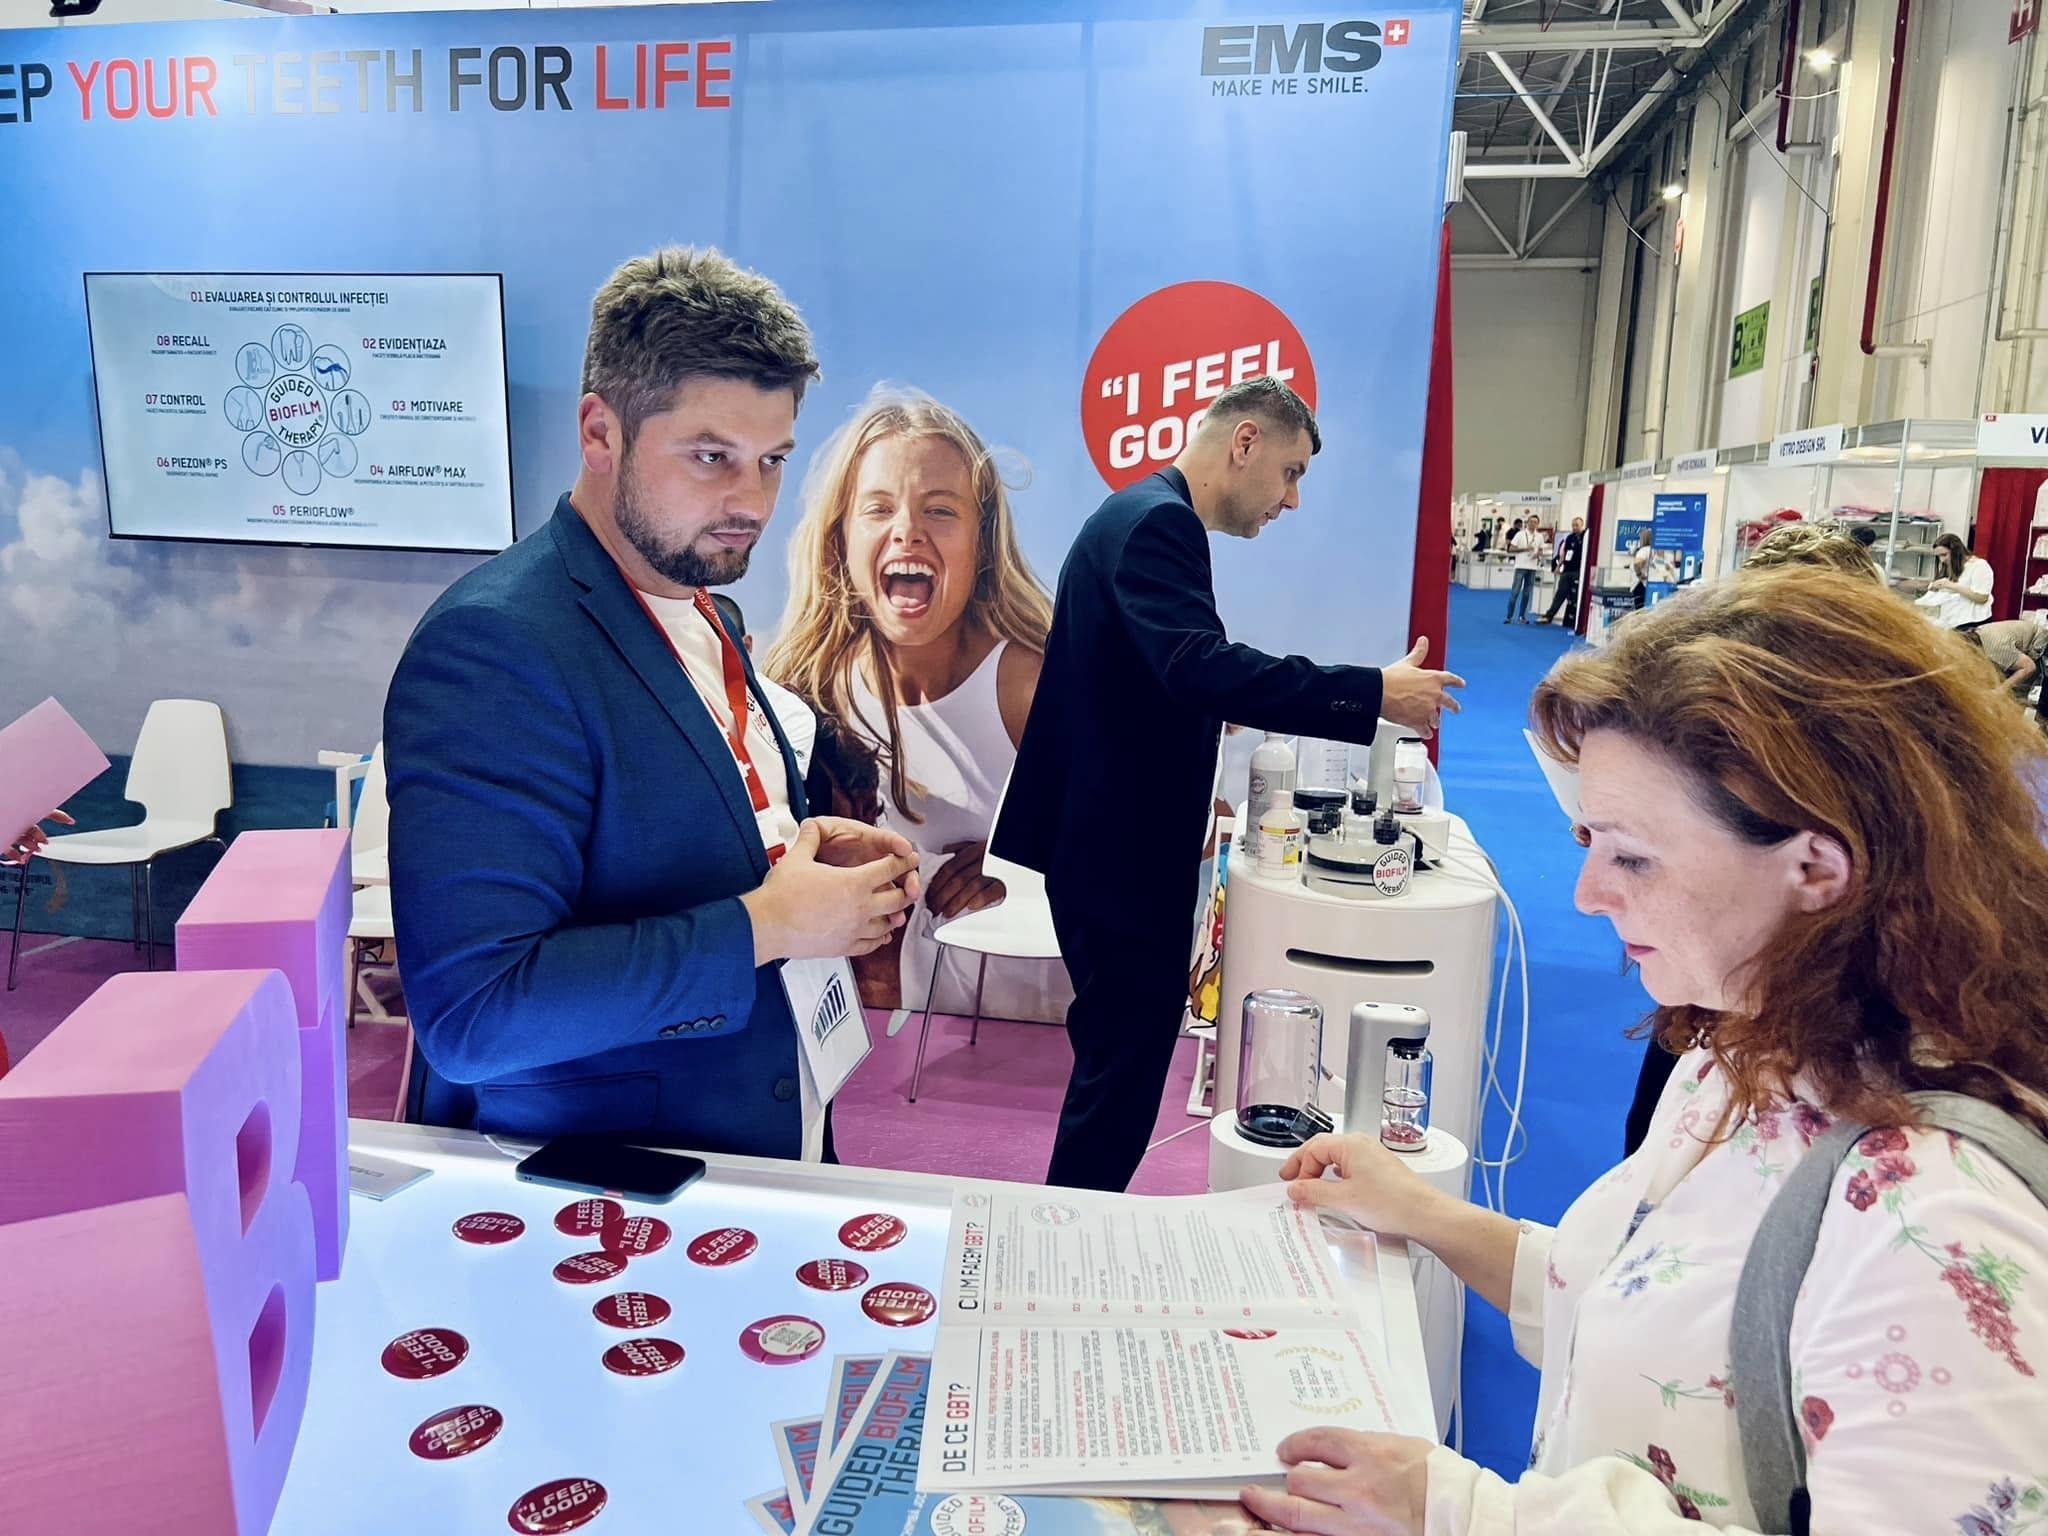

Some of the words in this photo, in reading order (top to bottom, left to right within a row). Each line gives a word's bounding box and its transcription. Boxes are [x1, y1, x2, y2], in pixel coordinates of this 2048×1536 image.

[1201, 20, 1382, 76] EMS
[67, 57, 218, 120] YOUR
[233, 49, 423, 115] TEETH
[448, 46, 573, 111] FOR
[595, 42, 731, 110] LIFE
[1212, 80, 1262, 97] MAKE
[1272, 79, 1298, 95] ME
[1307, 77, 1369, 94] SMILE.
[191, 291, 204, 303] 01
[205, 291, 264, 303] EVALUAREA
[278, 292, 338, 304] CONTROLUL
[156, 335, 170, 346] 08
[172, 335, 210, 347] RECALL
[362, 338, 376, 349] 02
[1162, 340, 1294, 408] FEEL
[145, 394, 158, 405] 07
[160, 394, 206, 406] CONTROL
[270, 379, 314, 403] GUIDED
[269, 400, 321, 421] BIOFILM
[392, 400, 406, 411] 03
[411, 400, 463, 412] MOTIVARE
[1109, 409, 1209, 470] GO
[156, 456, 170, 467] 06
[215, 458, 228, 470] PS
[370, 465, 384, 476] 04
[444, 467, 466, 478] MAX
[272, 505, 286, 516] 05
[1379, 852, 1407, 867] GUIDED
[1376, 866, 1407, 878] BIOFILM
[577, 1200, 590, 1219] FEEL
[460, 1221, 499, 1231] FEEL
[623, 1218, 641, 1238] FEEL
[860, 1214, 891, 1233] FEEL
[963, 1221, 985, 1246] GBT?
[709, 1229, 741, 1248] FEEL
[585, 1257, 618, 1272] FEEL
[960, 1247, 983, 1275] FACEM
[833, 1266, 847, 1286] FEEL
[867, 1298, 908, 1309] FEEL
[958, 1279, 979, 1310] CUM
[632, 1301, 649, 1324] FEEL
[398, 1335, 430, 1358] FEEL
[641, 1346, 668, 1370] FEEL
[946, 1383, 972, 1419] GBT?
[945, 1424, 969, 1447] CE
[816, 1444, 888, 1536] GUIDED
[863, 1357, 929, 1440] BIOFILM
[942, 1449, 967, 1473] DE
[543, 1480, 596, 1505] FEEL
